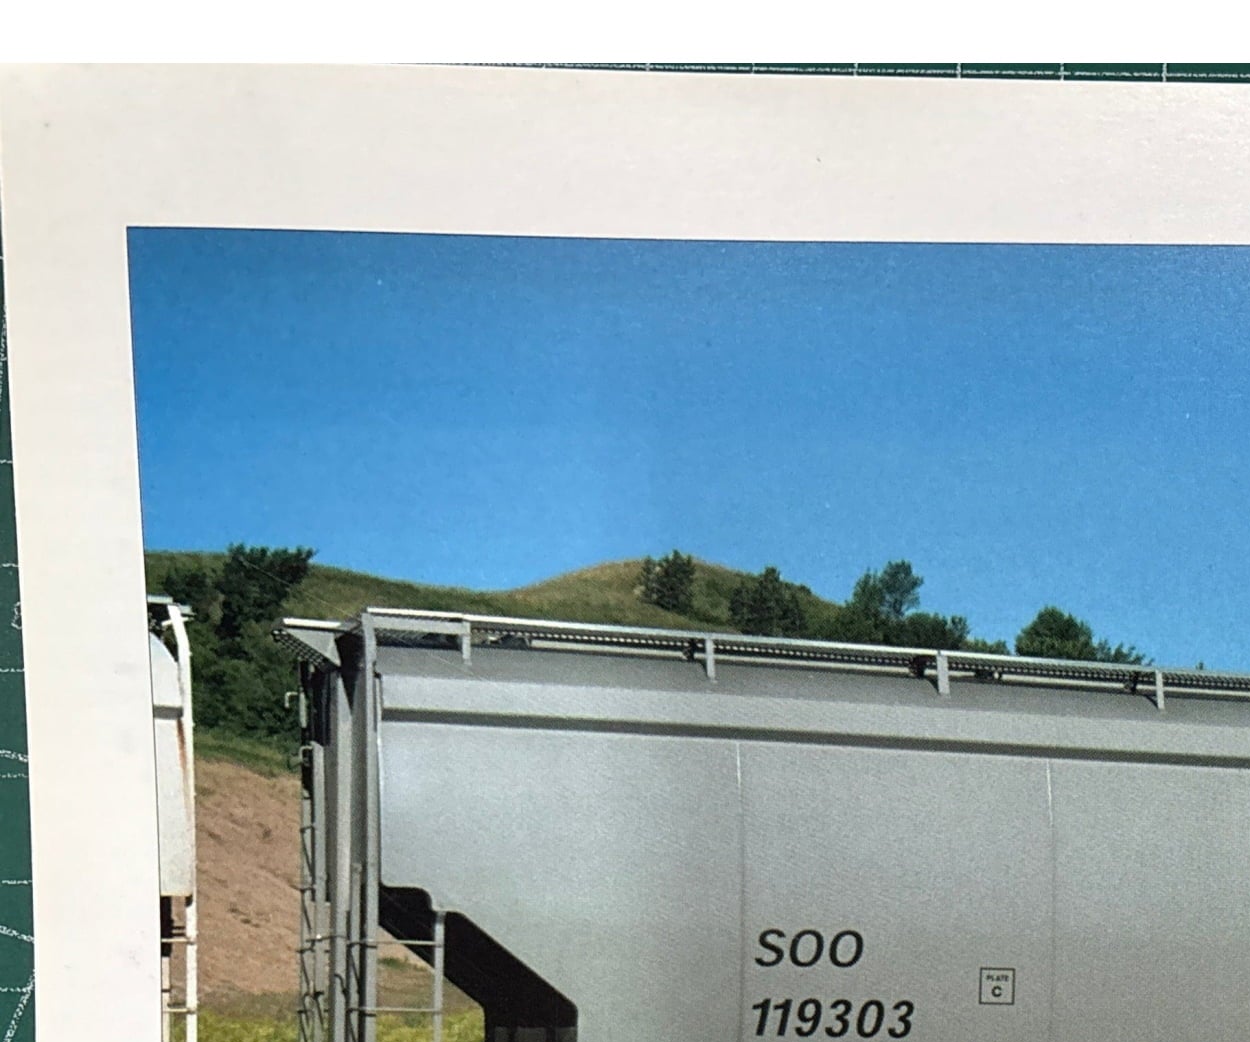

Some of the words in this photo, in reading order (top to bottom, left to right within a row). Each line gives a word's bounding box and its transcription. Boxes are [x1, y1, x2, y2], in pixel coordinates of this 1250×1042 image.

[754, 928, 864, 968] SOO
[991, 985, 1002, 998] C
[751, 997, 915, 1039] 119303
